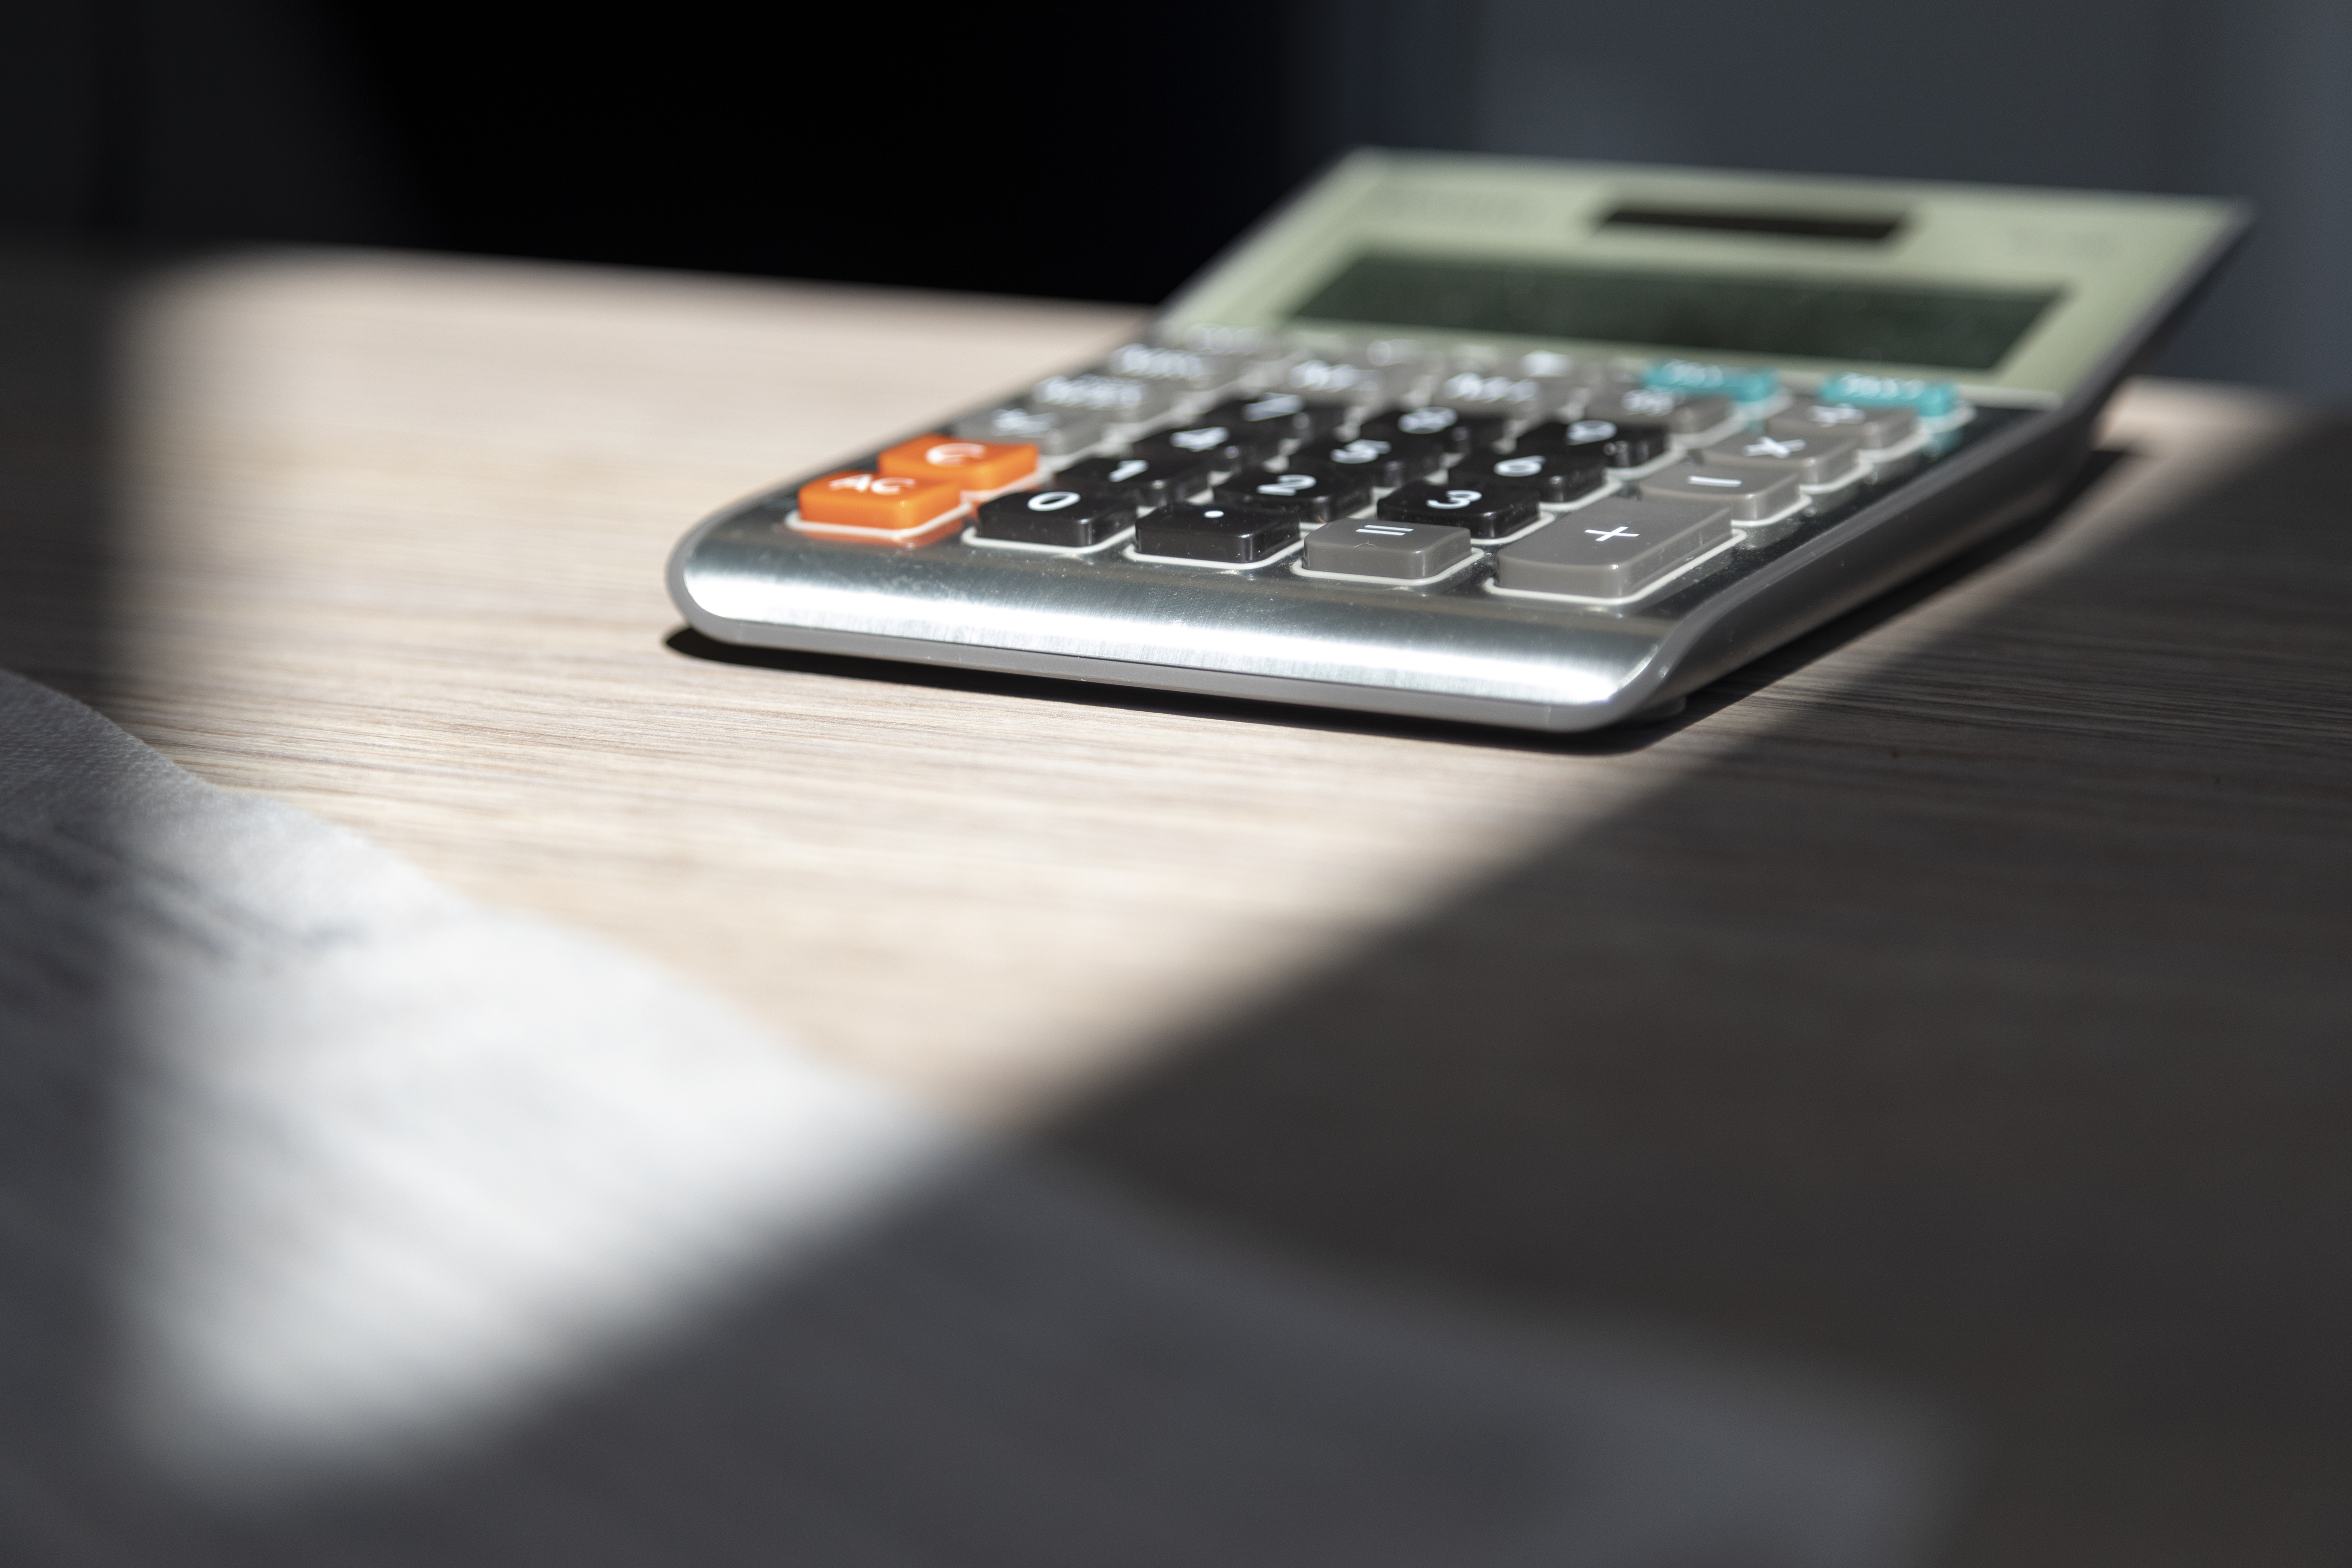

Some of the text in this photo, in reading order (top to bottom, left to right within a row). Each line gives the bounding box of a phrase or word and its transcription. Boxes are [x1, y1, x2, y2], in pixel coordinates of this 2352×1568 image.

[926, 443, 985, 464] C
[1108, 460, 1148, 482] 1
[1494, 455, 1546, 477] 6
[829, 474, 916, 494] AC
[1257, 474, 1316, 496] 2
[1028, 491, 1081, 511] 0
[1426, 489, 1482, 509] 3
